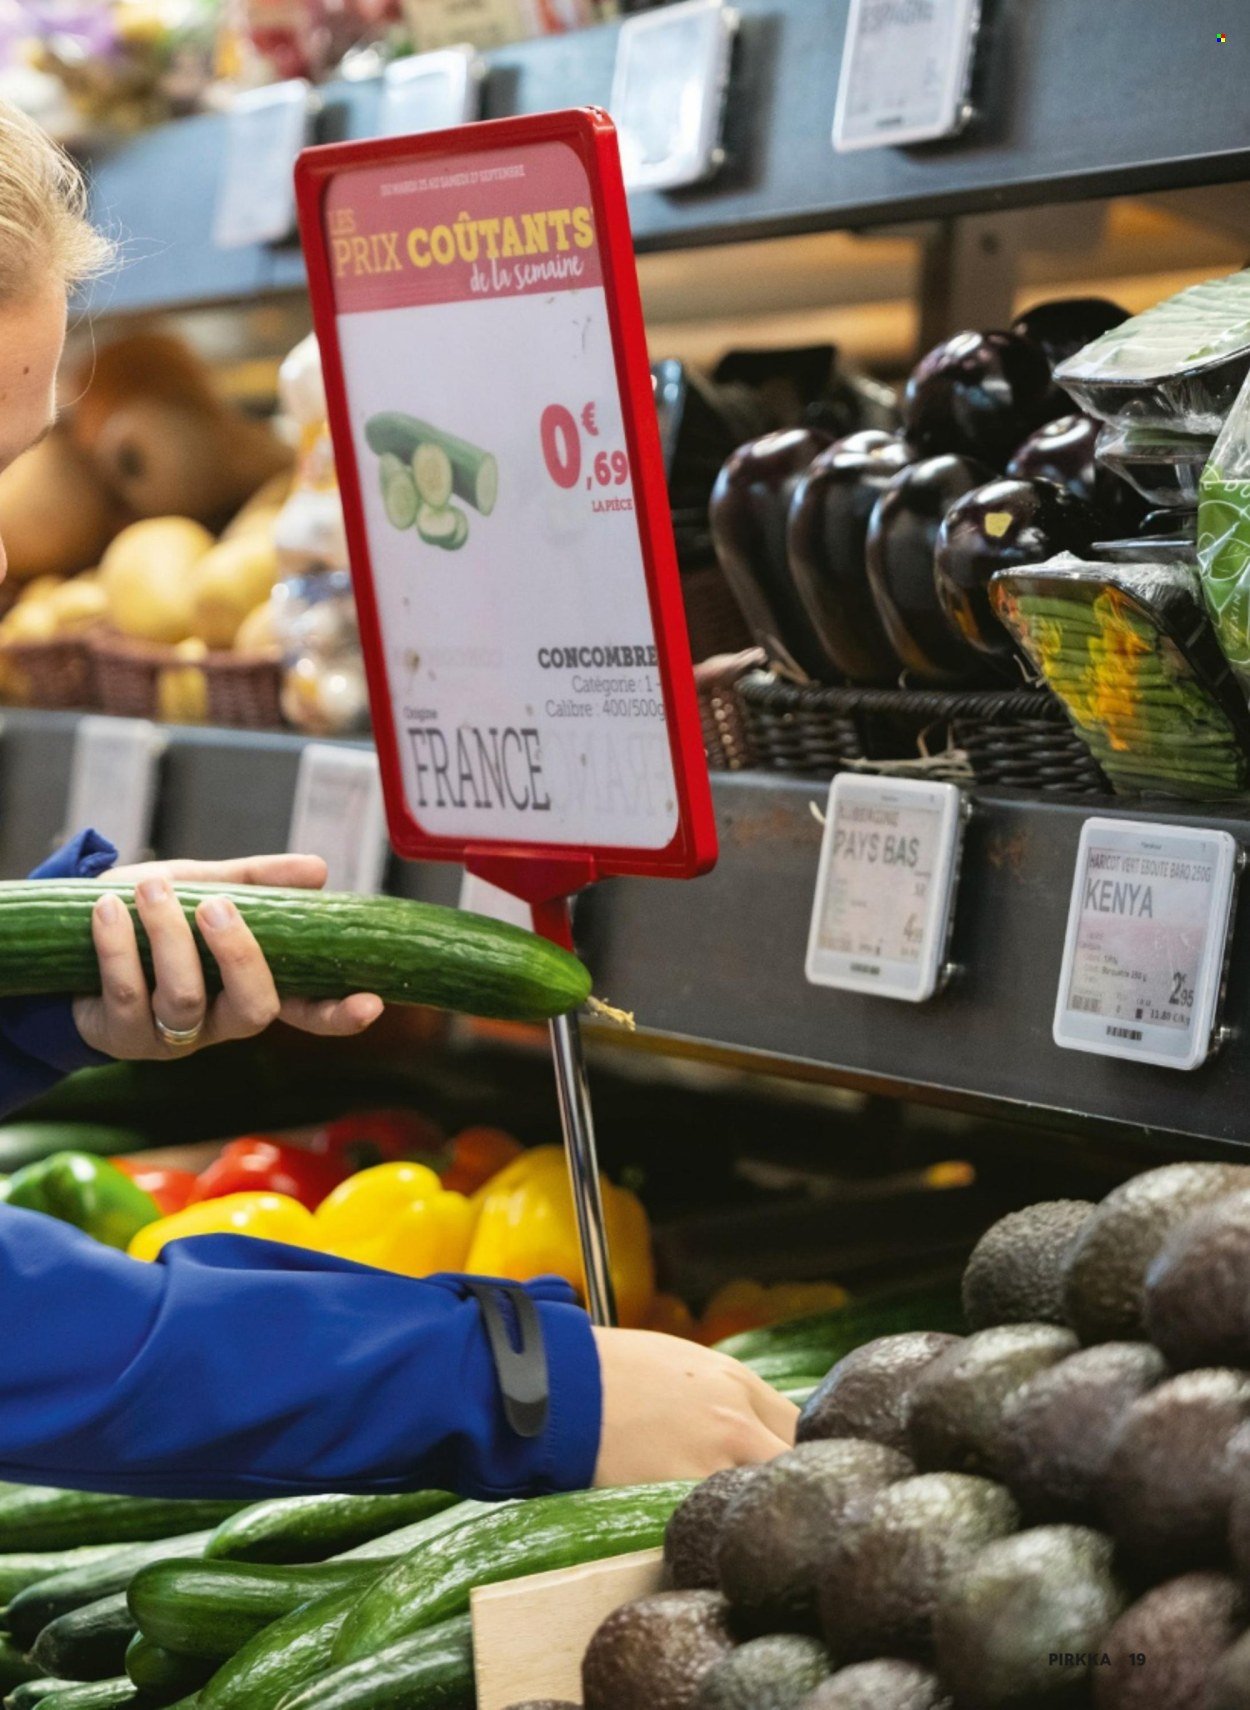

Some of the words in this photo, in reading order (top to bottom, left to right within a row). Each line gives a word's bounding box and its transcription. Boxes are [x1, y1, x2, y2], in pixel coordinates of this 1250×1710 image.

[328, 208, 356, 236] LES
[331, 231, 403, 278] PRIX
[407, 206, 595, 268] COÛTANTS
[470, 262, 490, 292] de
[491, 257, 512, 291] la
[514, 254, 585, 290] semaine
[592, 499, 606, 513] LA
[538, 645, 658, 669] CONCOMBRE
[545, 699, 593, 718] Calibre
[408, 727, 551, 811] FRANCE
[833, 829, 880, 864] PAYS
[883, 834, 920, 868] BAS
[1087, 852, 1121, 871] HARICOT
[1122, 857, 1140, 874] VERT
[1085, 878, 1153, 918] KENYA
